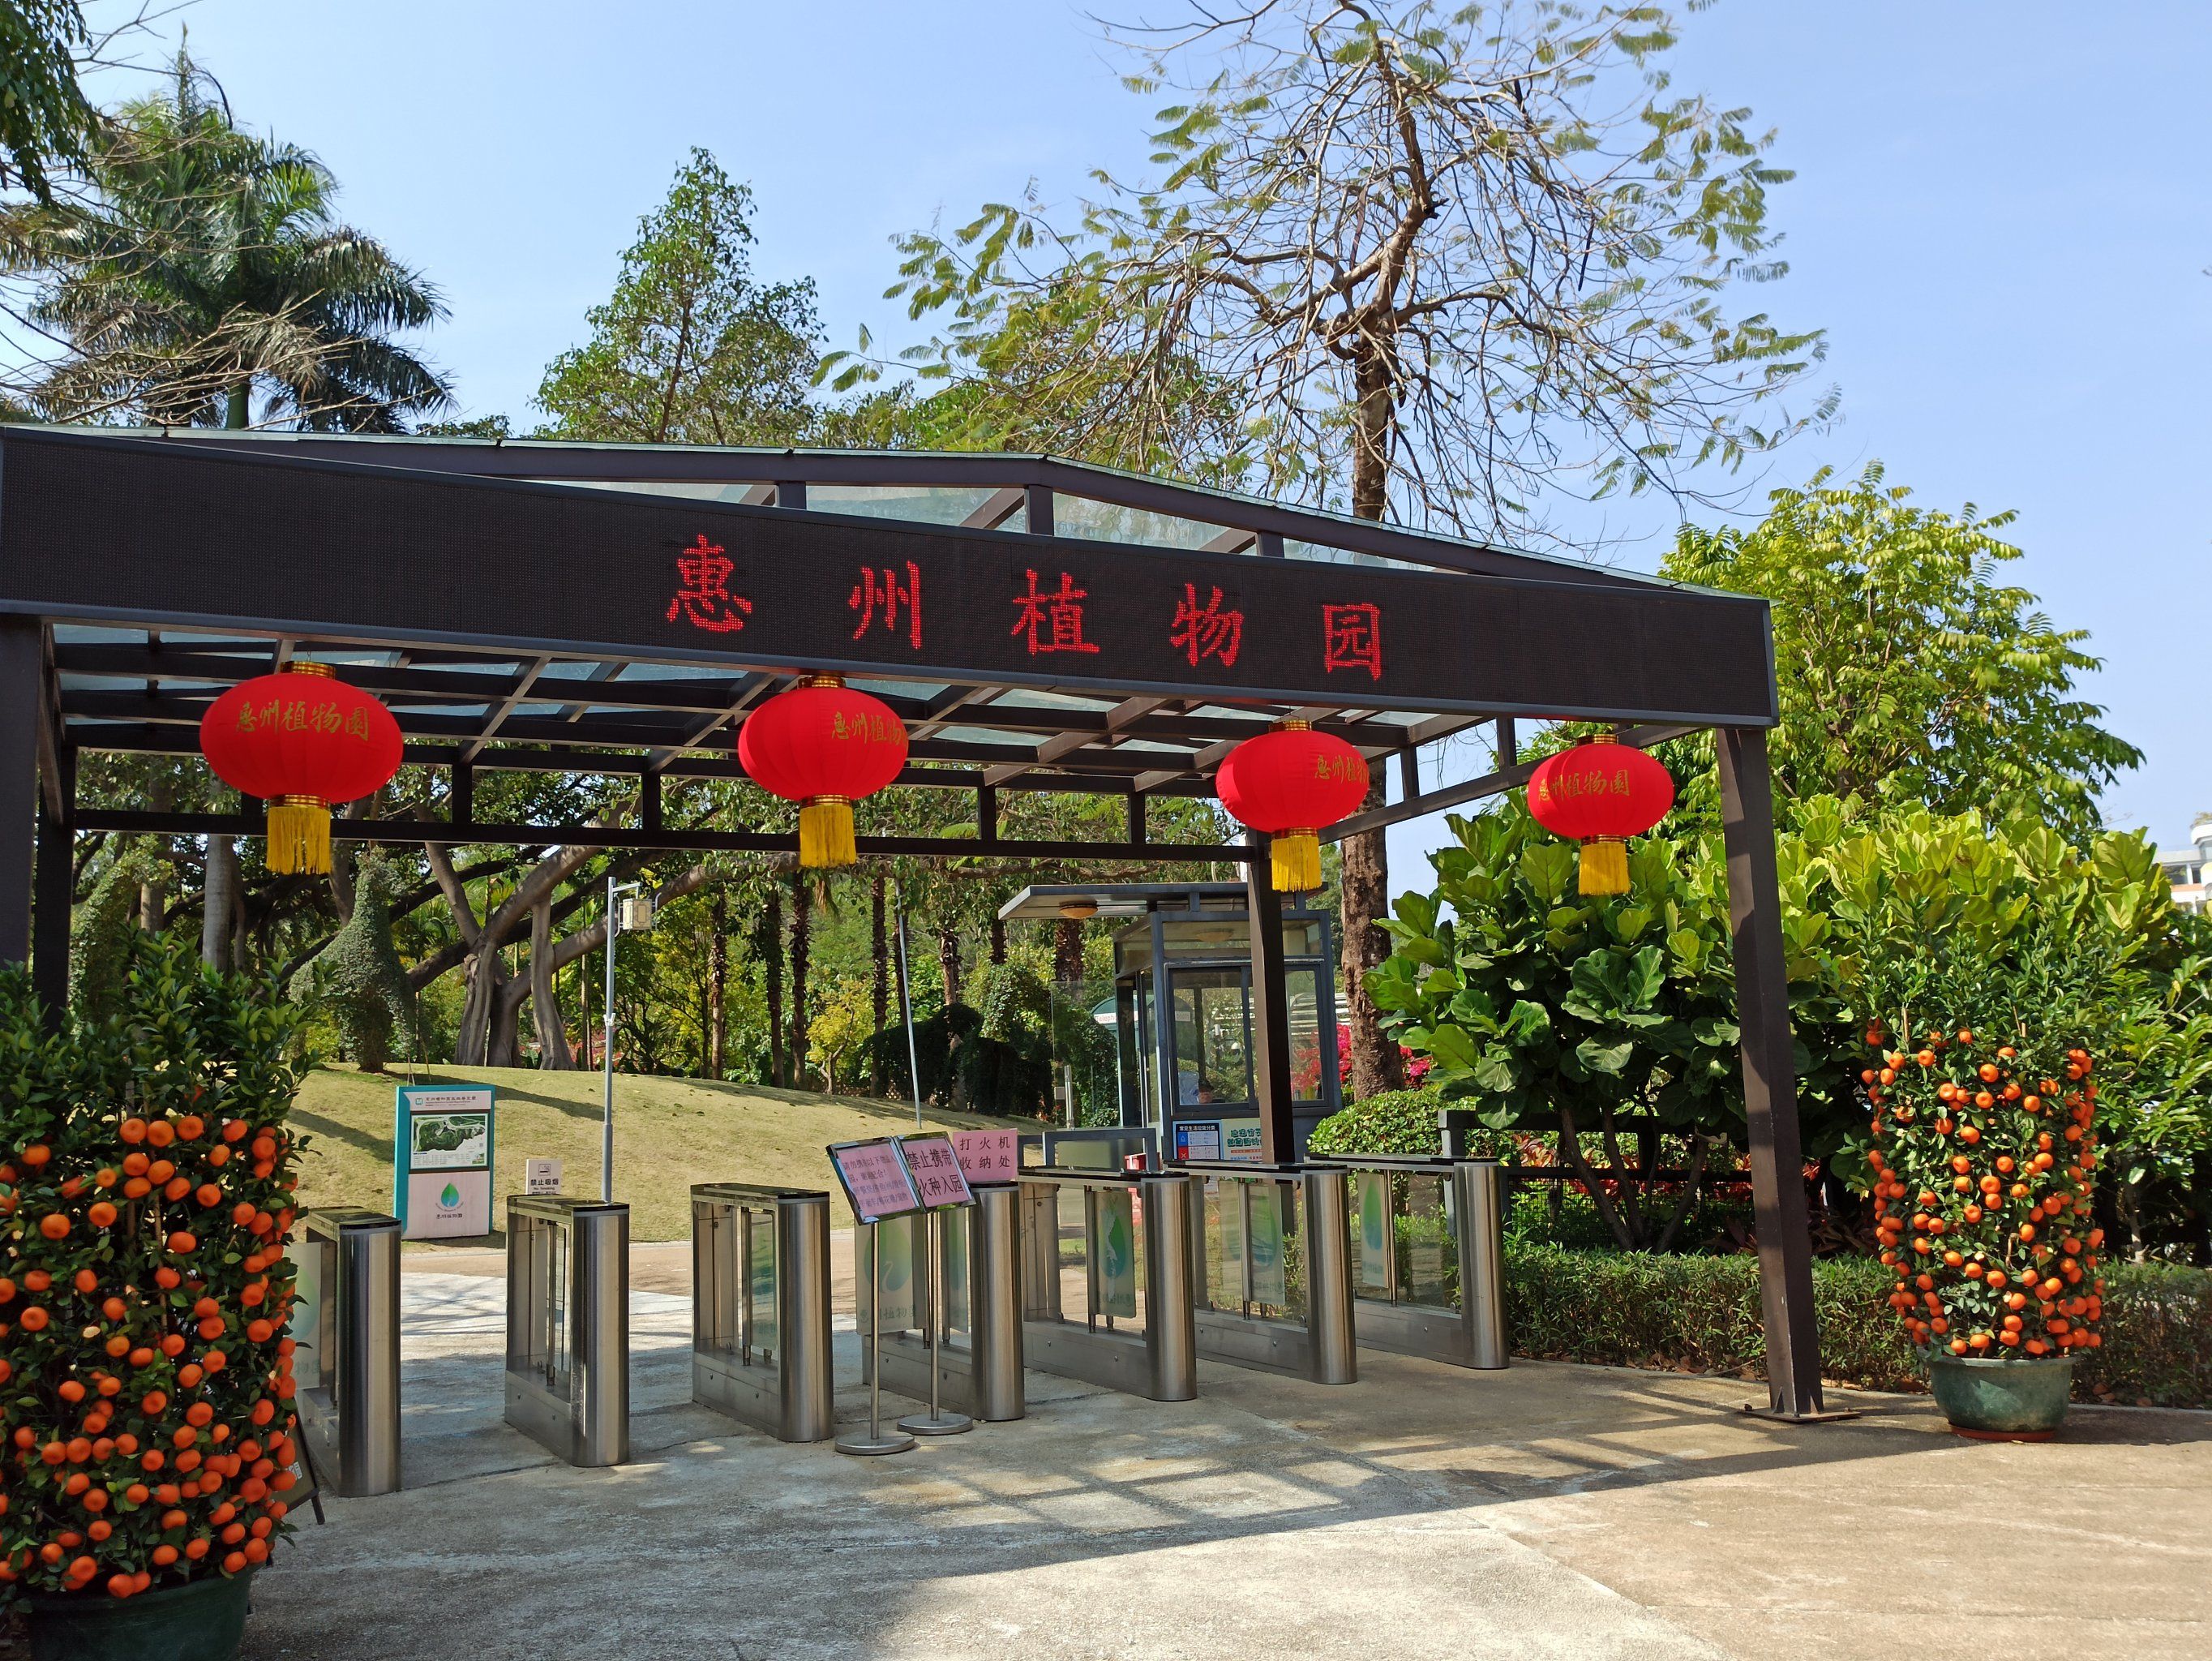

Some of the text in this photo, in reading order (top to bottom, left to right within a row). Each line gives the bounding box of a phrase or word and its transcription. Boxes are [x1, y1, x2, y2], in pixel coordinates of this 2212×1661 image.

[667, 533, 1382, 681] 惠州植物园
[960, 1135, 1010, 1151] 打火机
[907, 1148, 953, 1170] 禁止携带
[960, 1155, 1010, 1170] 收纳处
[919, 1174, 964, 1199] 火种入园
